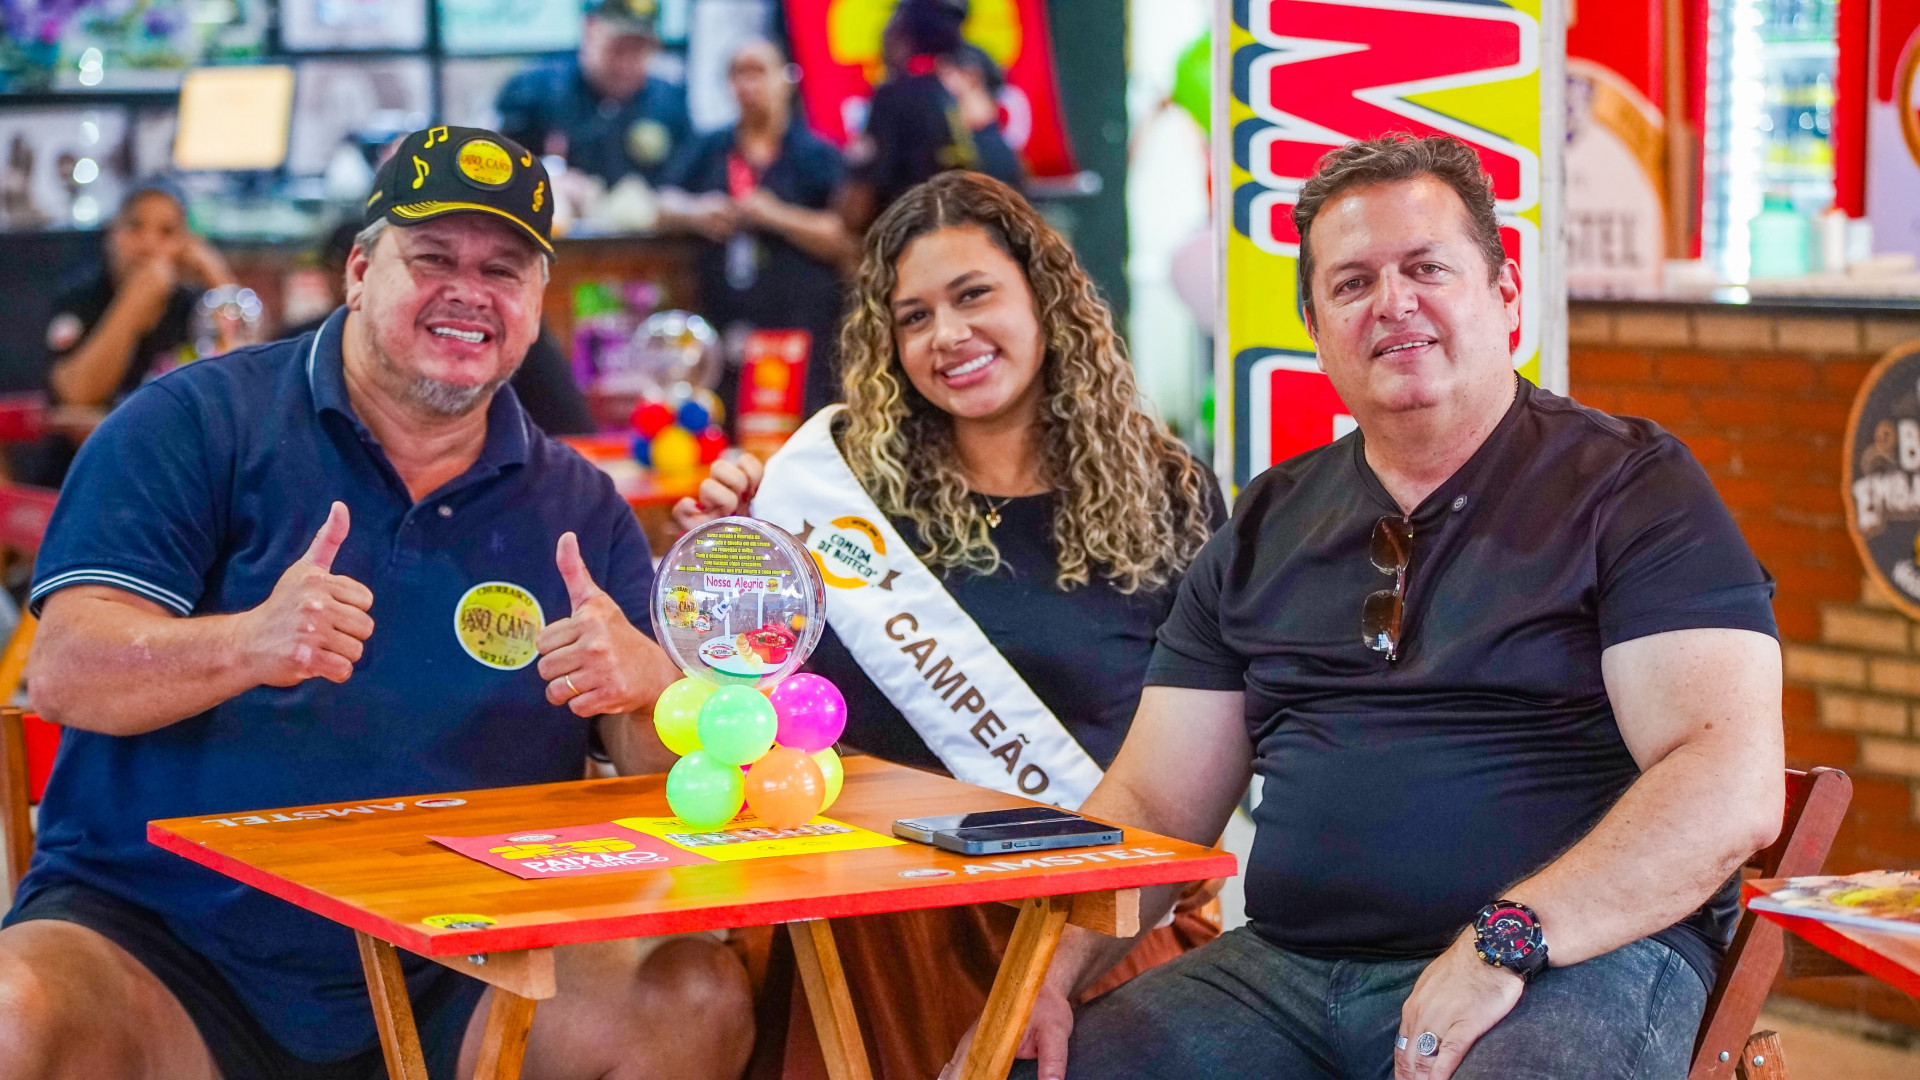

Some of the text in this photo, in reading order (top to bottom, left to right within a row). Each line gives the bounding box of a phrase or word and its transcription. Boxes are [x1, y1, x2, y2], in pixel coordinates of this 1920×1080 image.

[830, 533, 871, 564] COMIDA
[706, 575, 732, 588] Nossa
[734, 578, 764, 591] Alegria
[885, 612, 1049, 795] CAMPEÃO
[201, 801, 406, 828] AMSTEL
[520, 850, 658, 871] PAIXÃO
[962, 846, 1176, 875] AMSTEL
